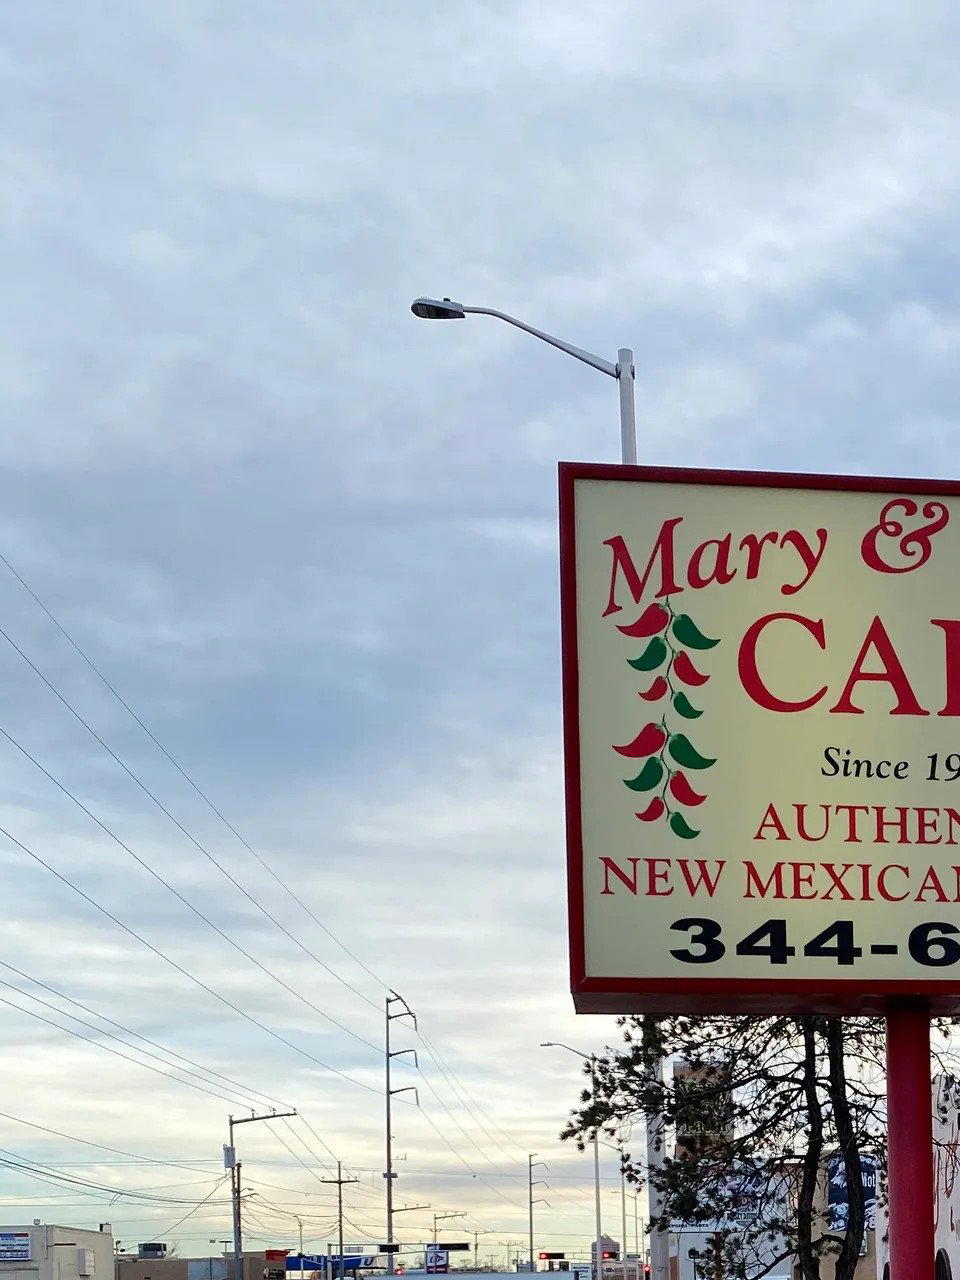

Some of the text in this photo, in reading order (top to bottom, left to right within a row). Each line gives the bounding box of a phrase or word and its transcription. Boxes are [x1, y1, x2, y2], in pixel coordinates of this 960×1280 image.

[602, 517, 828, 618] Mary
[860, 498, 949, 574] &
[820, 746, 909, 780] Since
[600, 857, 726, 898] NEW
